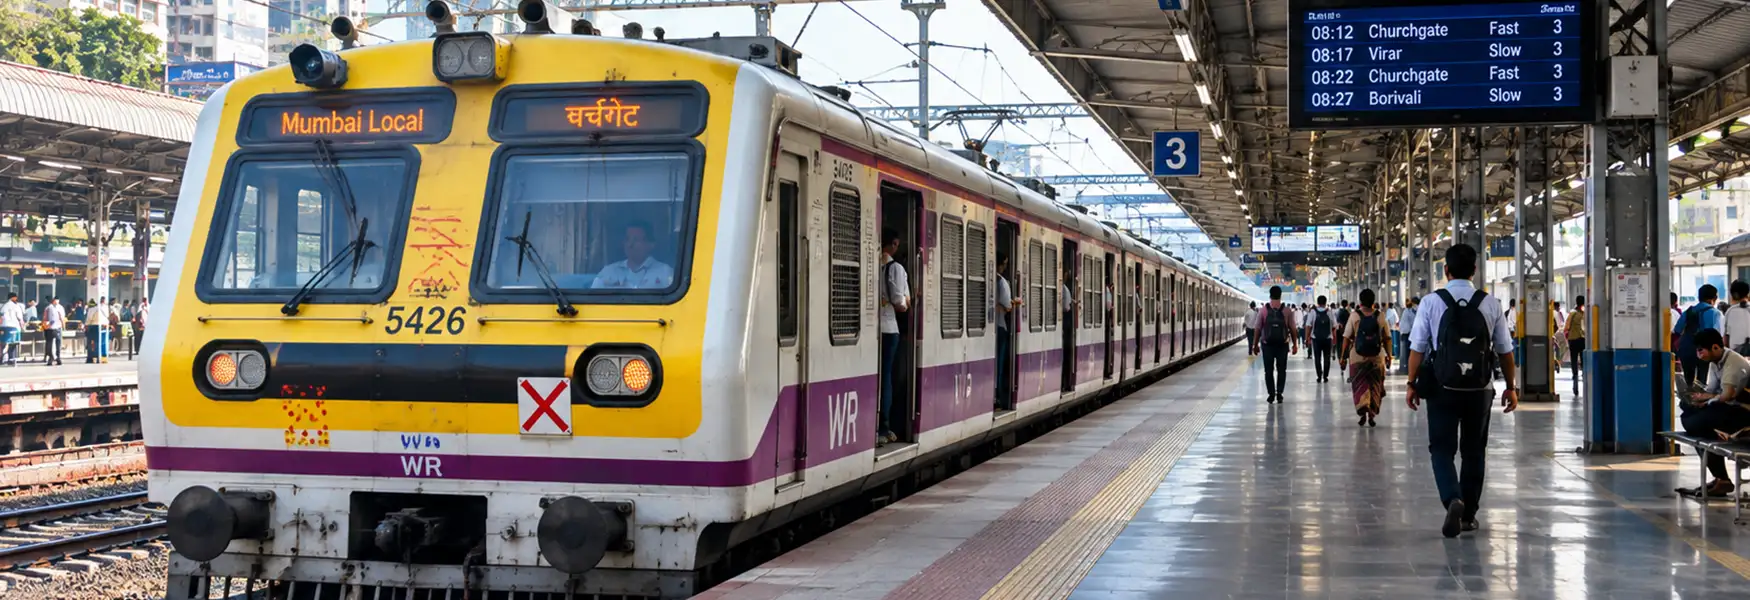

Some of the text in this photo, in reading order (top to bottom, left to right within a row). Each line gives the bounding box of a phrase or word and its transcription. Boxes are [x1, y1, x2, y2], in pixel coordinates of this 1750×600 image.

[1311, 19, 1562, 40] 08:12 Churchgate Fast 3
[1311, 41, 1562, 62] 08:17 Virar Slow 3
[1311, 63, 1562, 85] 08:22 Churchgate Fast 3
[1311, 86, 1562, 107] 08:27 Borivali Slow 3
[281, 107, 424, 135] Mumbai Local
[1165, 137, 1187, 170] 3
[384, 306, 467, 336] 5426
[828, 390, 859, 451] WR
[400, 455, 443, 477] WR
